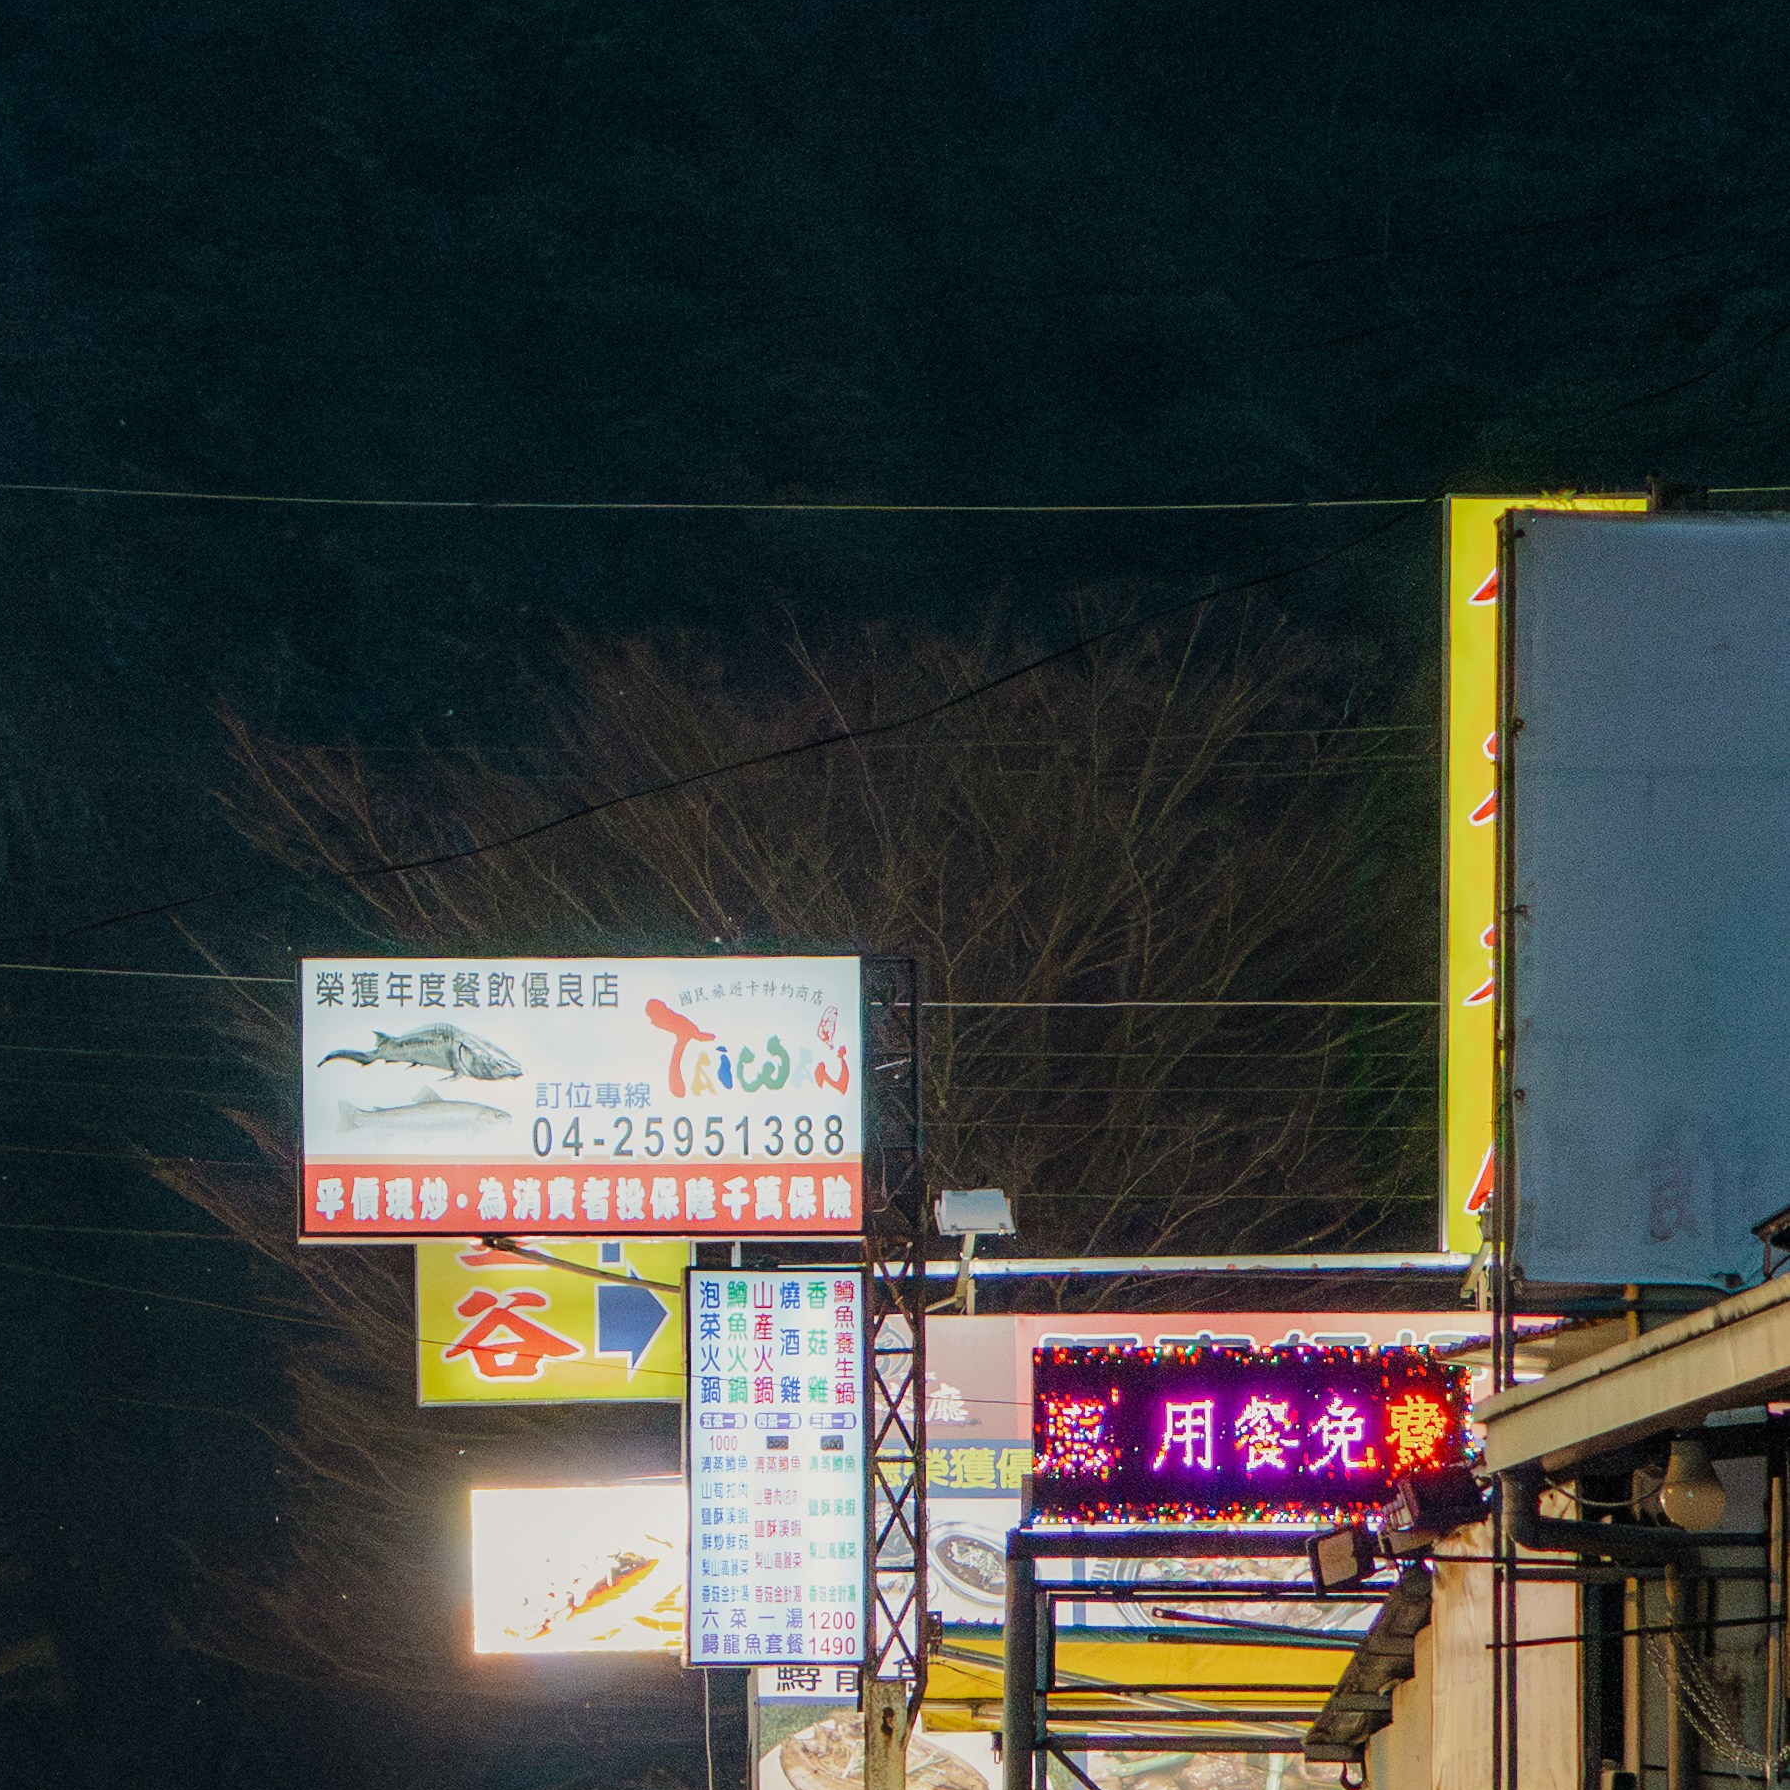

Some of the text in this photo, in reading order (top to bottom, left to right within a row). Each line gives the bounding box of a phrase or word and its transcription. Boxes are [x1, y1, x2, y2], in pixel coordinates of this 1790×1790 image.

[316, 972, 620, 1009] 榮獲年度餐飲優良店
[535, 1081, 652, 1109] 訂位專線
[532, 1115, 846, 1158] 04-25951388
[700, 1280, 721, 1405] 泡菜火鍋
[753, 1280, 774, 1405] 山產火鍋
[709, 1435, 738, 1451] 1000
[702, 1608, 856, 1630] 六菜一湯 1200
[809, 1637, 856, 1655] 1490
